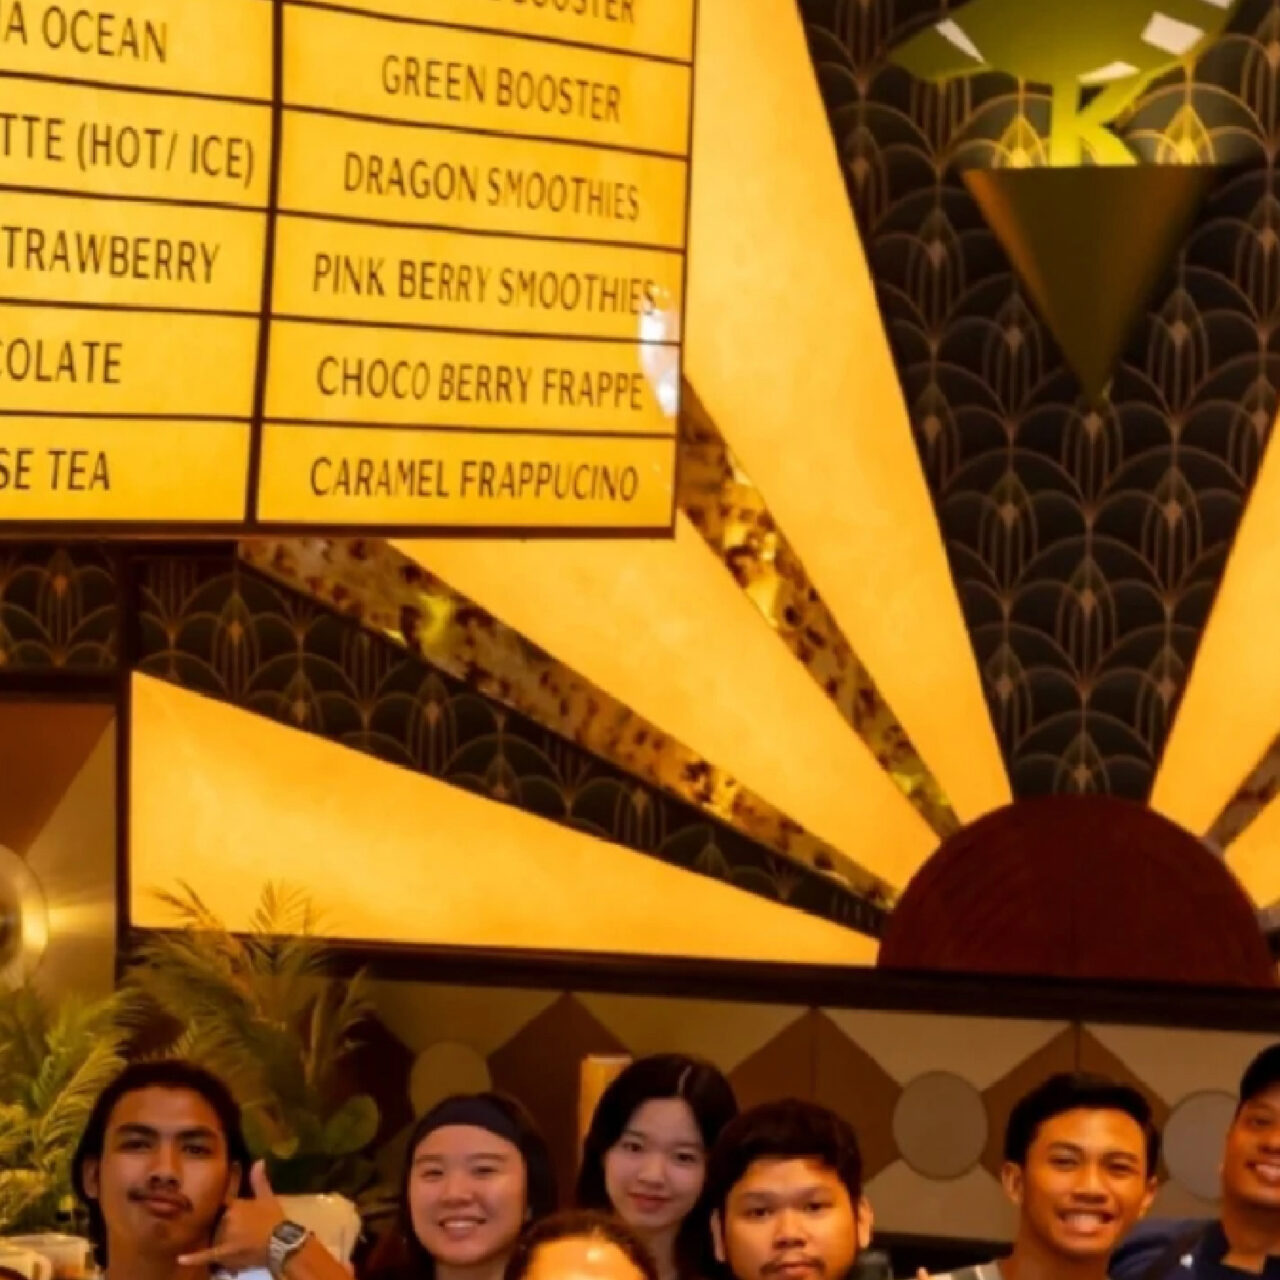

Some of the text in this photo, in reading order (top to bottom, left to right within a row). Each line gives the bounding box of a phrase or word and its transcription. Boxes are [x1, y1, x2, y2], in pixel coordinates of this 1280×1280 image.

[41, 5, 167, 63] OCEAN
[382, 54, 621, 122] GREEN BOOSTER
[343, 151, 640, 222] DRAGON SMOOTHIES
[313, 253, 660, 317] PINK BERRY SMOOTHIES
[317, 355, 645, 412] CHOCO BERRY FRAPPE
[47, 448, 111, 492] TEA
[309, 456, 638, 503] CARAMEL FRAPPUCINO
